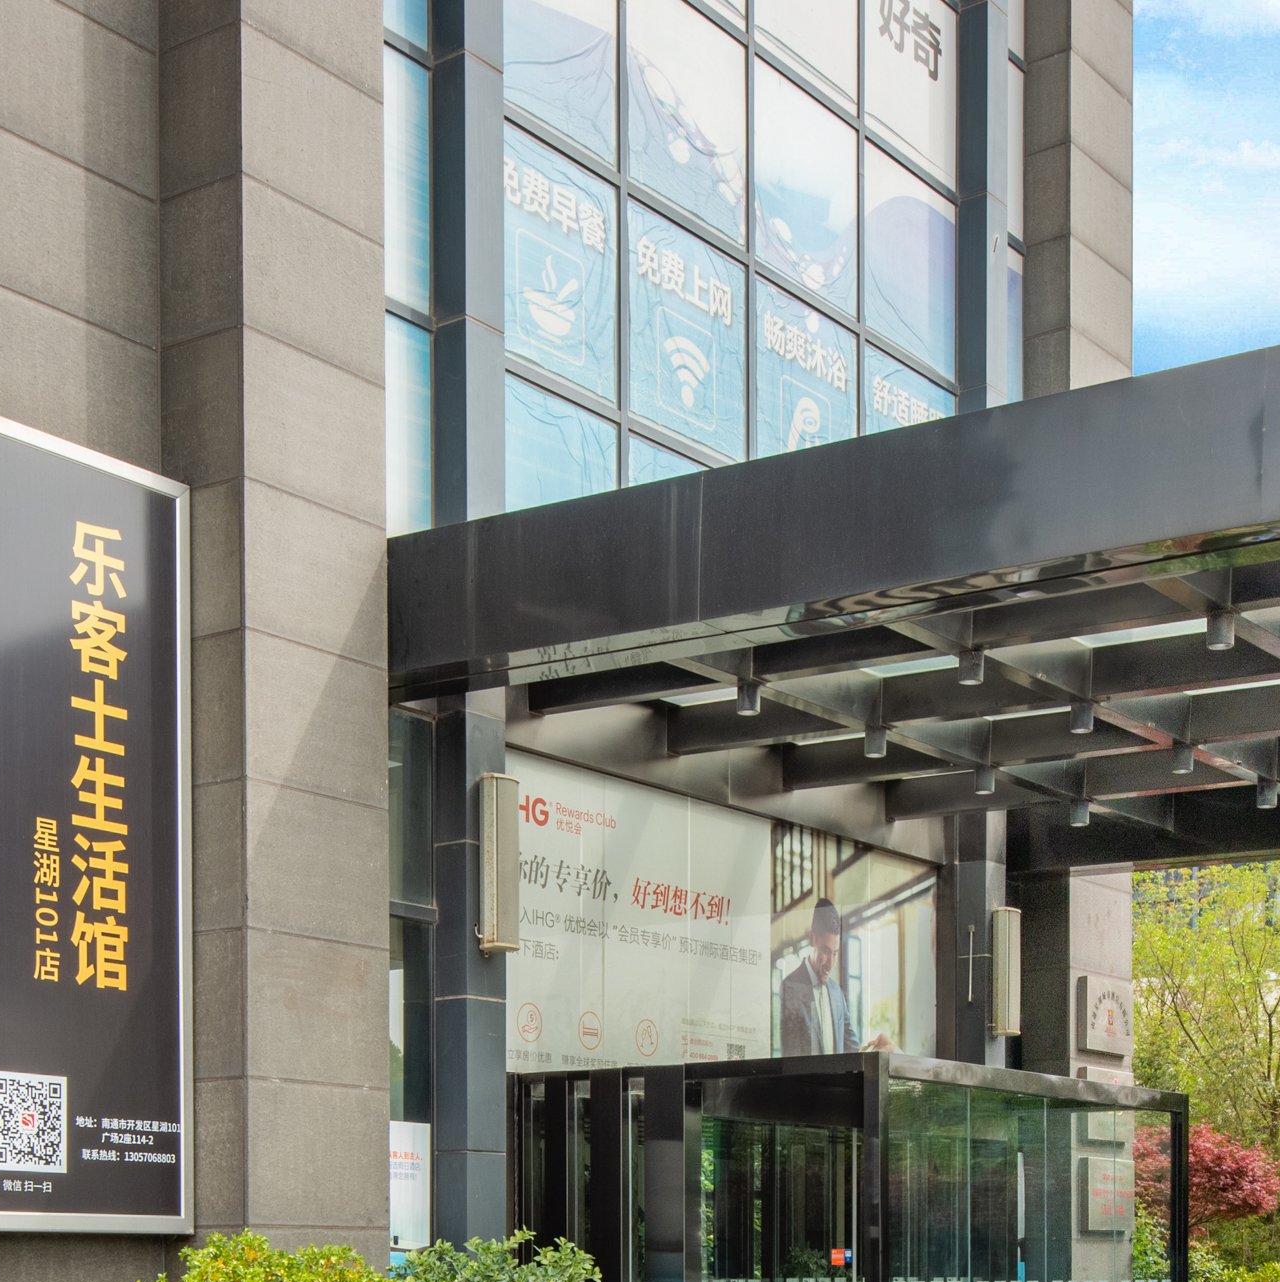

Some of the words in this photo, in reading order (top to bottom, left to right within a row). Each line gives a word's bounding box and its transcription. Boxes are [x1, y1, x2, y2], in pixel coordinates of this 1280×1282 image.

[504, 155, 606, 255] 免费早餐
[635, 235, 733, 328] 免费上网
[762, 310, 849, 393] 畅爽沐浴
[69, 520, 129, 992] 乐客士生活馆
[556, 802, 594, 823] Rewards
[595, 812, 617, 830] Club
[556, 818, 583, 835] 优悦会
[33, 816, 61, 983] 星湖101店
[3, 1179, 22, 1192] 微信
[24, 1180, 52, 1193] 扫一扫
